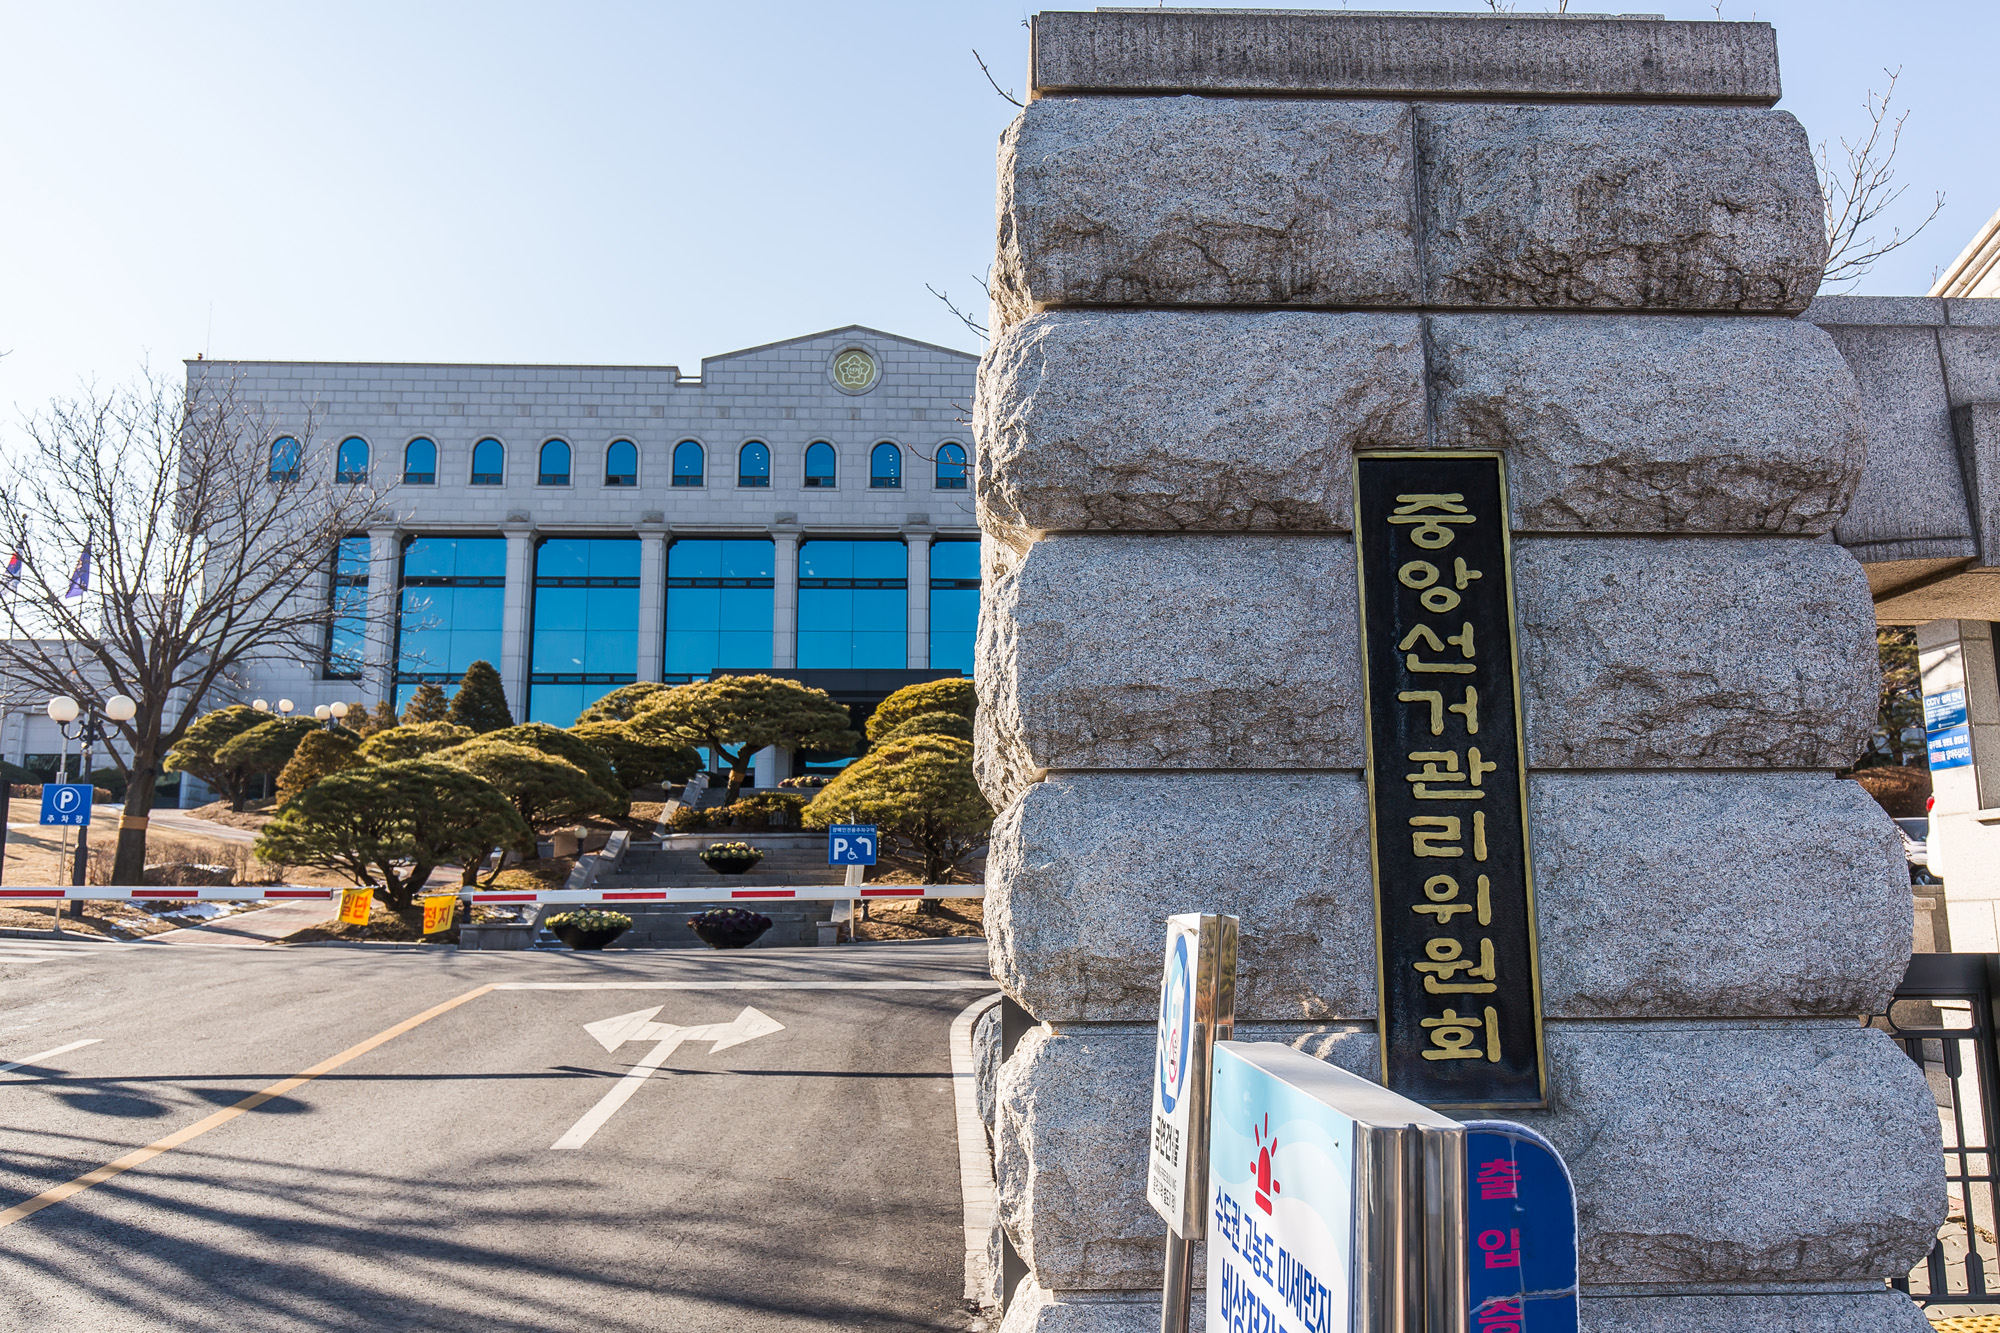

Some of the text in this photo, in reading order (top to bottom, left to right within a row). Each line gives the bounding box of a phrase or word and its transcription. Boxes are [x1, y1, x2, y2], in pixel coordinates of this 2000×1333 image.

[1926, 697, 1940, 707] CCTV
[1387, 492, 1501, 1063] 중앙선거관리위원회
[60, 791, 74, 809] P
[46, 814, 84, 824] 주차장
[834, 838, 848, 860] P
[341, 893, 368, 919] 일단
[424, 905, 451, 929] 정지
[1155, 1115, 1180, 1168] 금연건물
[1215, 1185, 1241, 1254] 수도권
[1242, 1212, 1274, 1288] 고농도
[1278, 1246, 1332, 1333] 미세먼지
